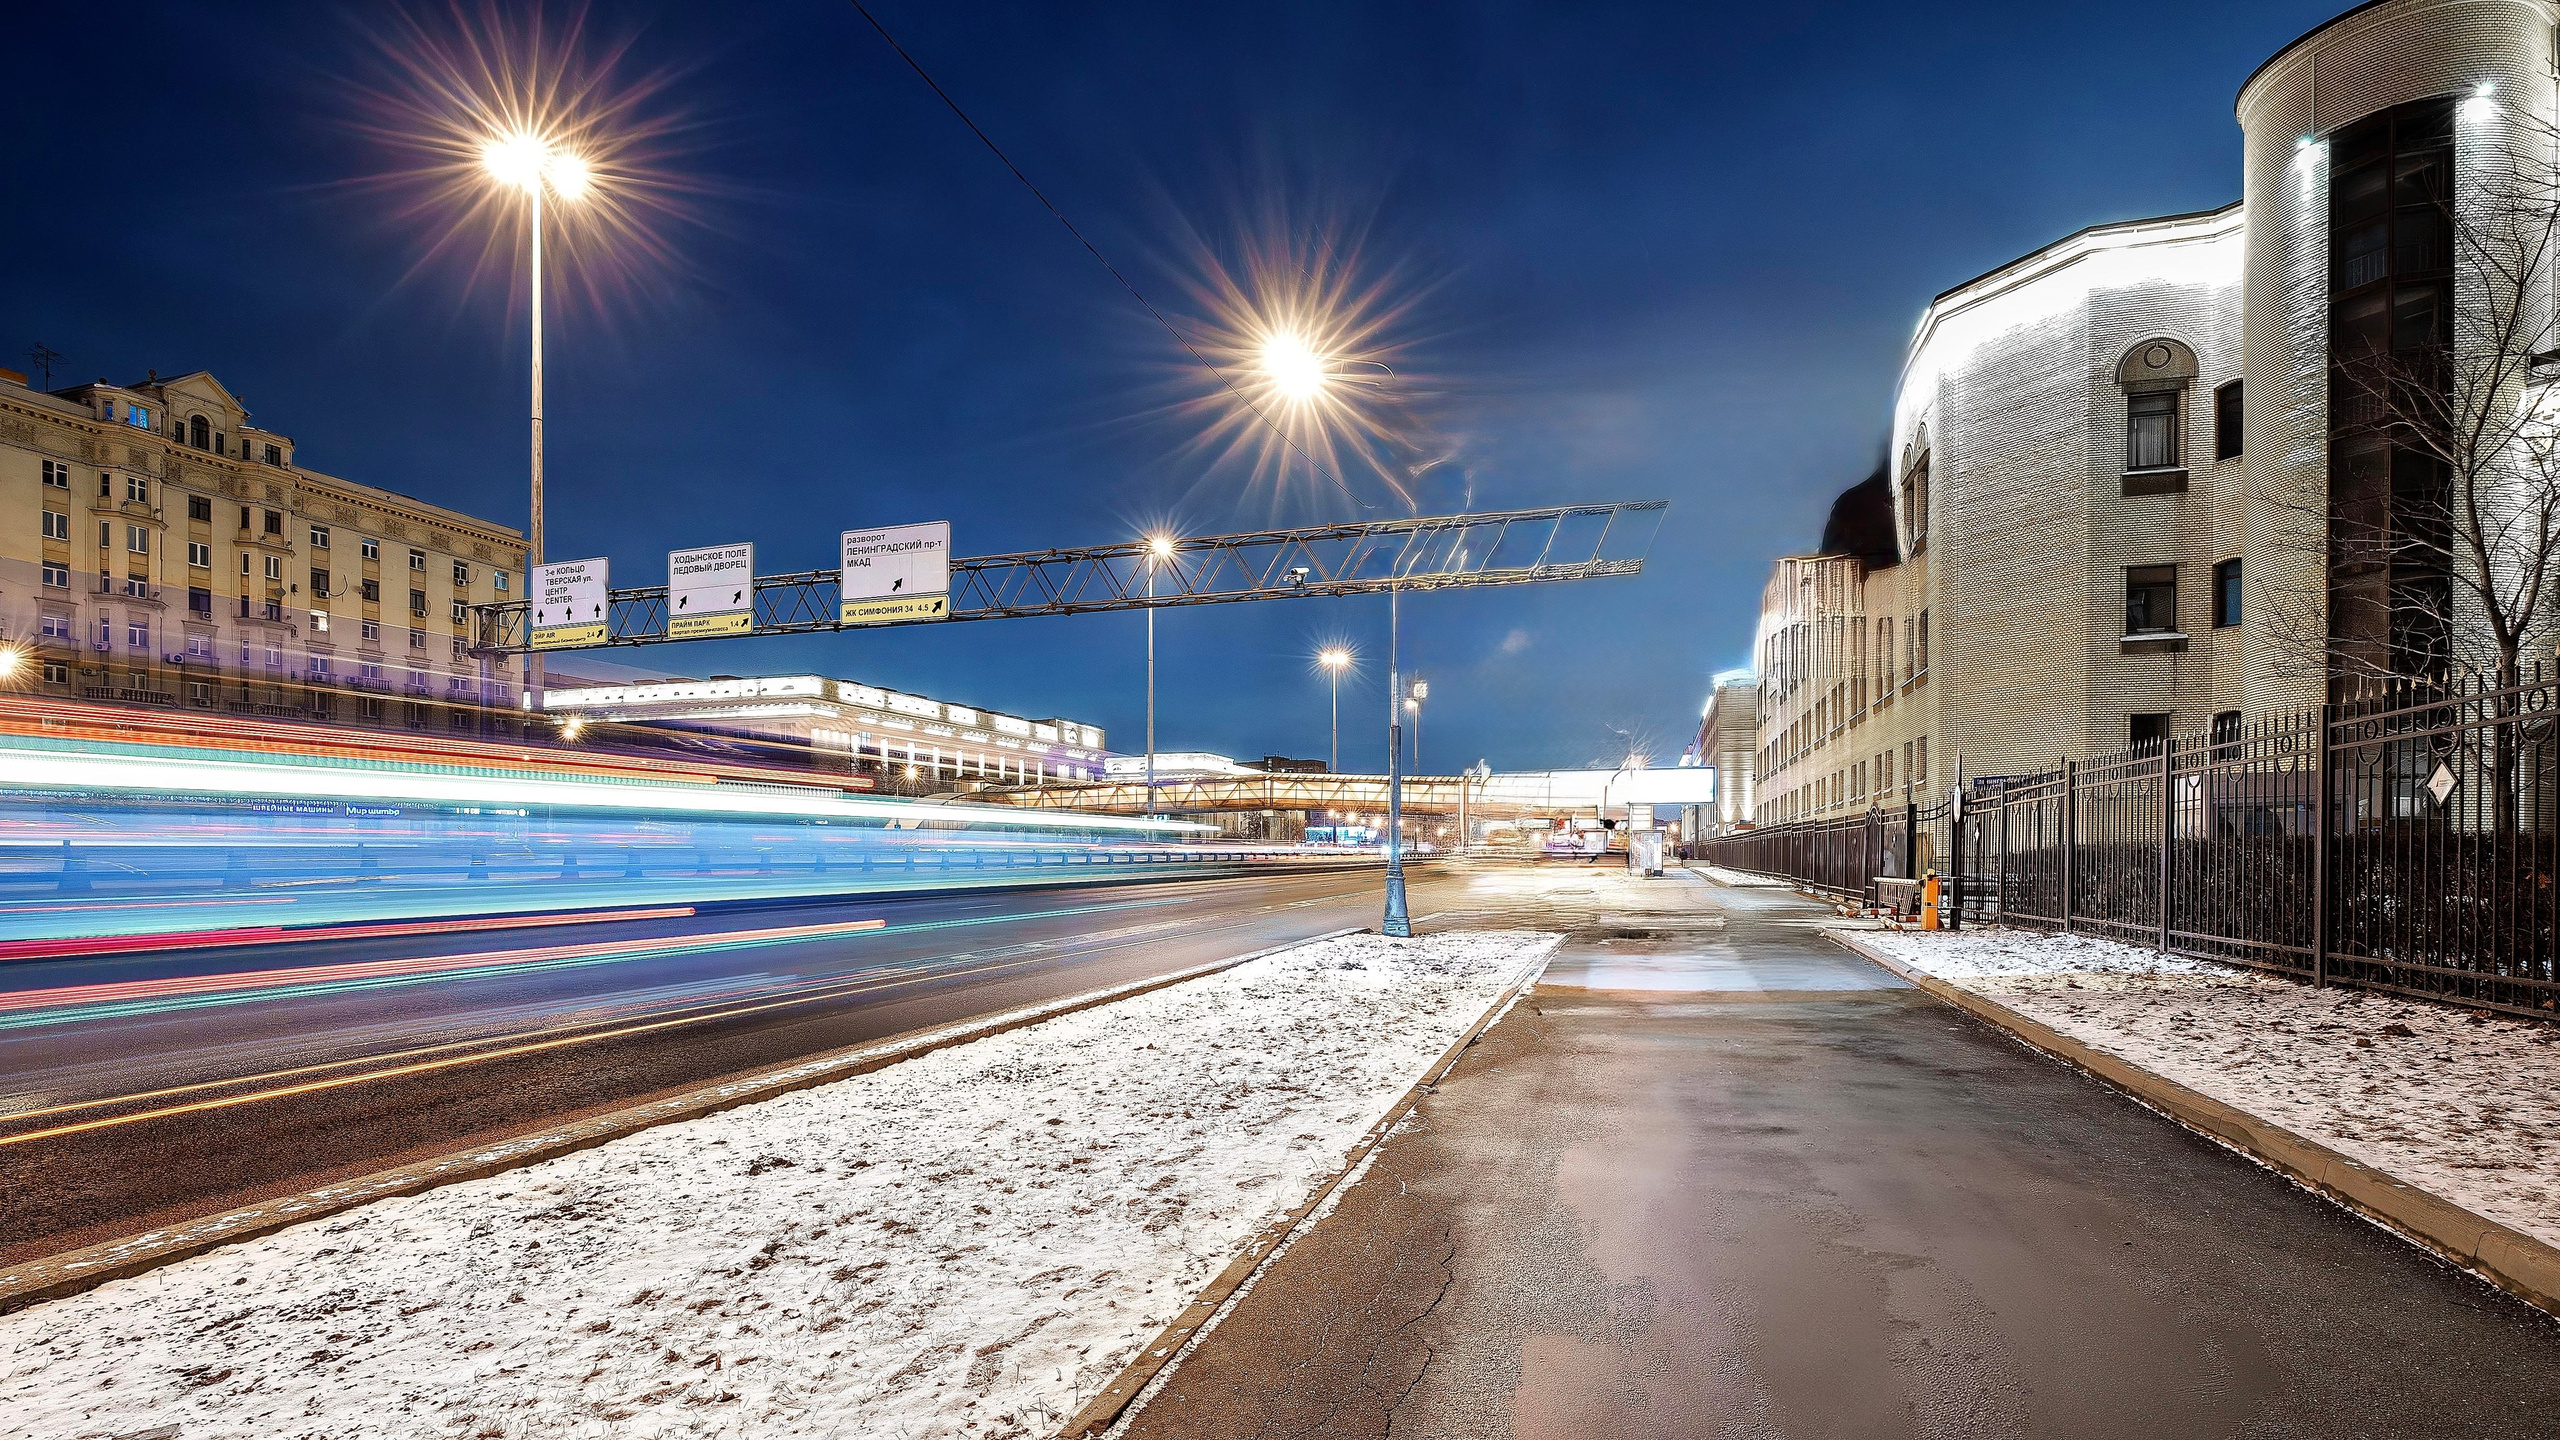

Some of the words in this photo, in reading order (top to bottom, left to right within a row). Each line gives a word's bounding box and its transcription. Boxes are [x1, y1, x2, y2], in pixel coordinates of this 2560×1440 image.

[847, 534, 886, 545] разворот
[846, 539, 922, 556] ЛЕНИНГРАДСКИЙ
[924, 540, 942, 549] пр-т
[674, 552, 723, 564] ХОДЫНСКОЕ
[725, 549, 747, 558] ПОЛЕ
[673, 562, 712, 575] ЛЕДОВЫЙ
[714, 560, 747, 572] ДВОРЕЦ
[847, 558, 871, 568] МКАД
[545, 569, 555, 577] 3-е
[556, 565, 585, 575] КОЛЬЦО
[545, 576, 581, 586] ТВЕРСКАЯ
[545, 587, 568, 597] ЦЕНТР
[545, 595, 573, 605] CENTER
[845, 609, 856, 617] ЖК
[858, 606, 903, 616] СИМФОНИЯ
[671, 620, 693, 628] ПРАЙМ
[694, 619, 711, 627] ПАРК
[546, 631, 556, 639] AIR
[295, 805, 334, 813] МАШИНЫ
[345, 806, 368, 816] Мир
